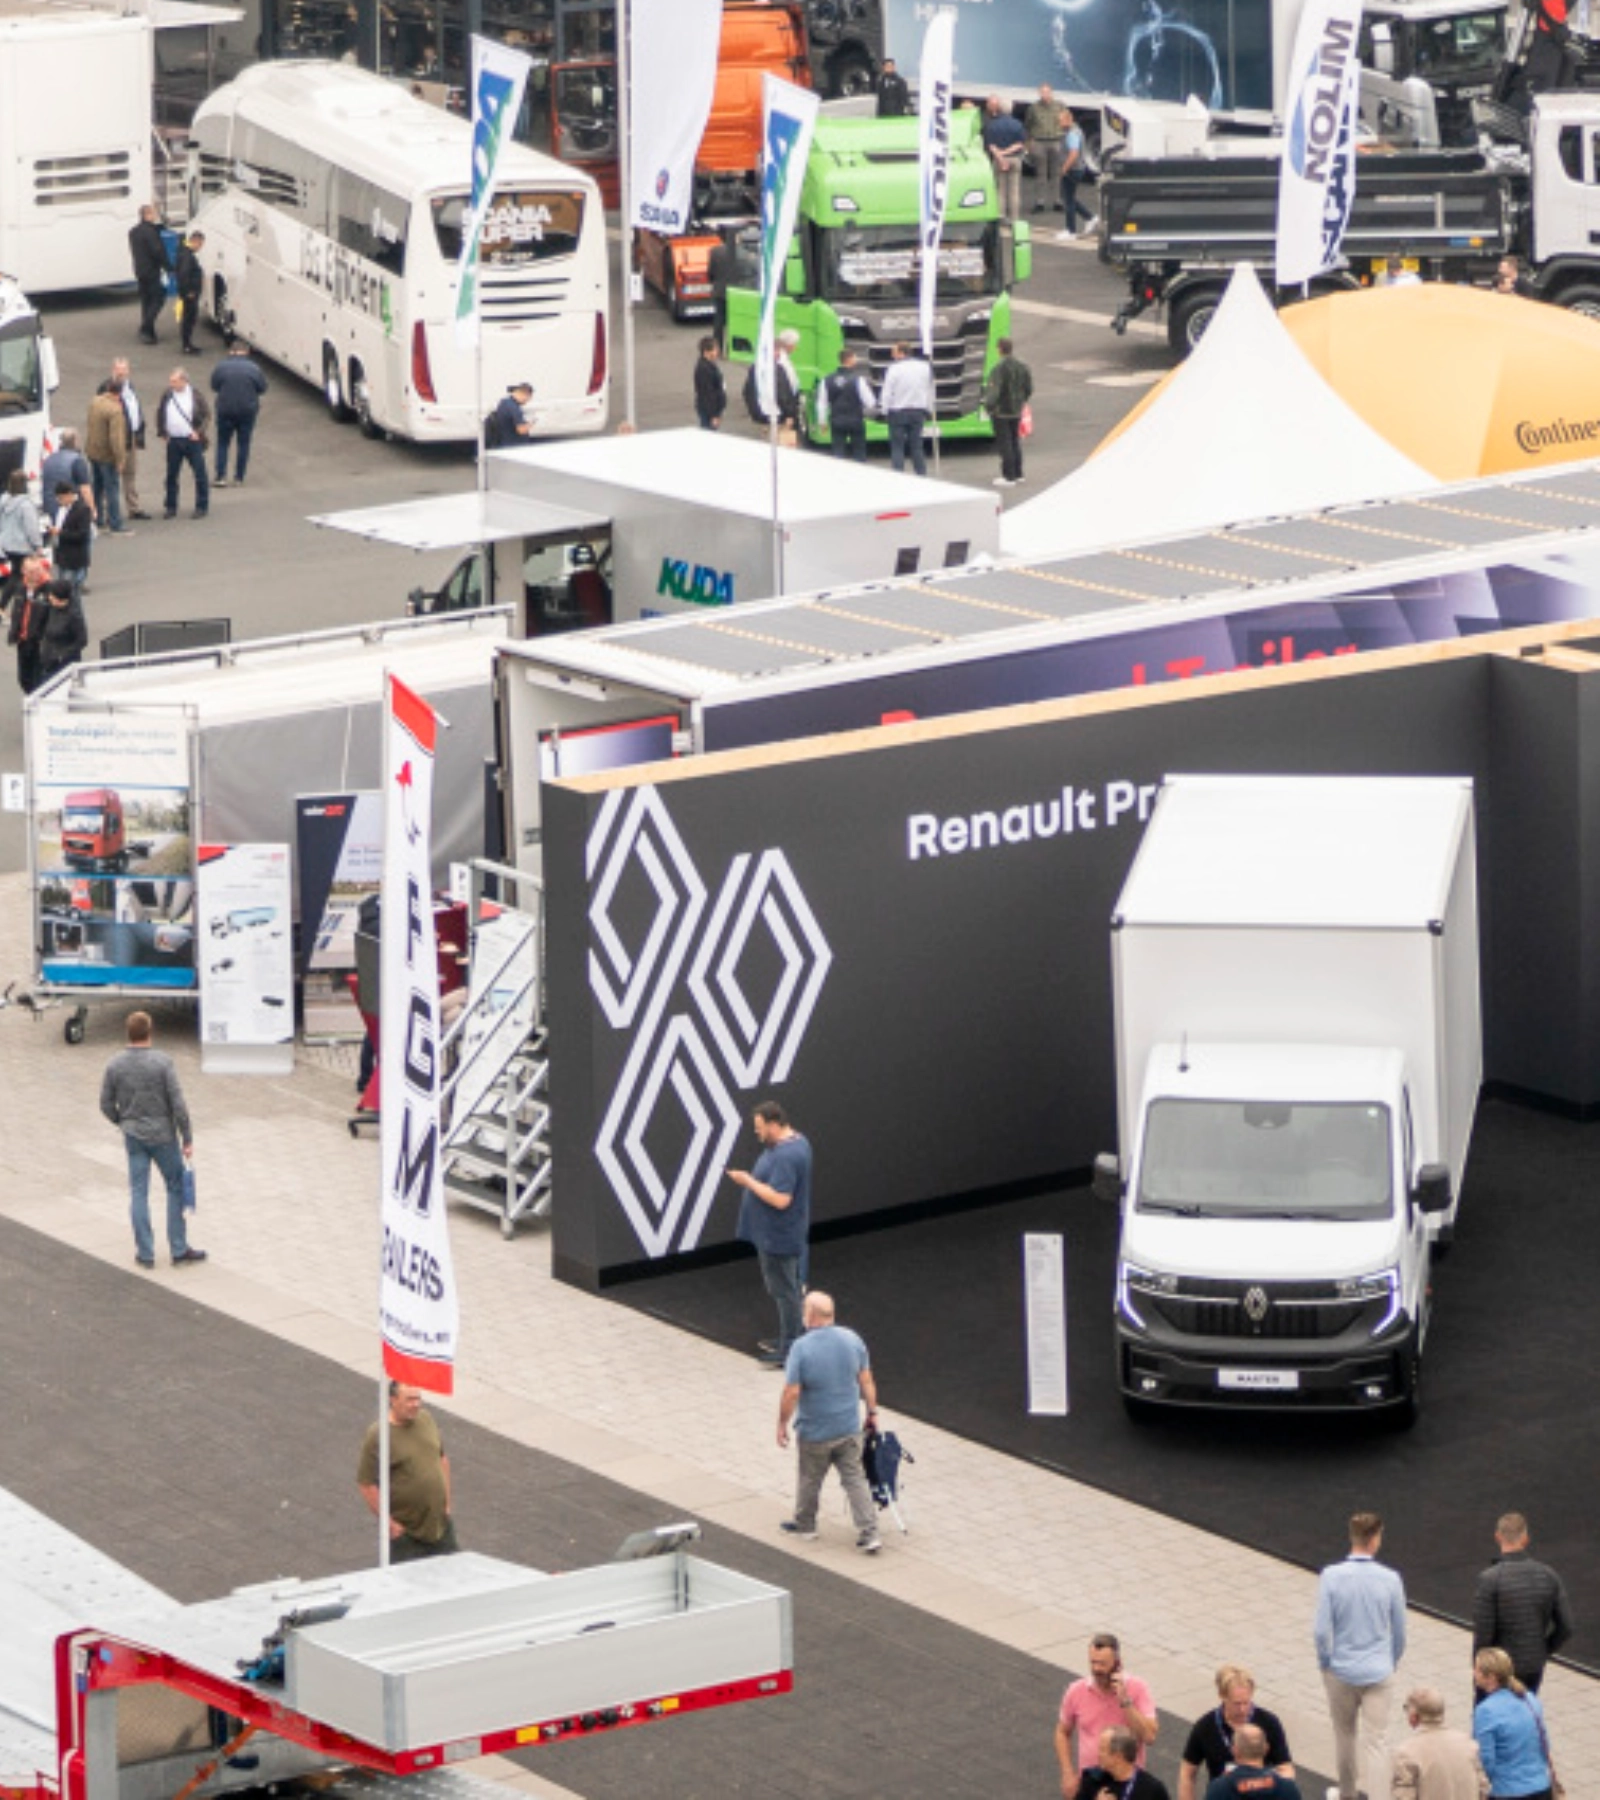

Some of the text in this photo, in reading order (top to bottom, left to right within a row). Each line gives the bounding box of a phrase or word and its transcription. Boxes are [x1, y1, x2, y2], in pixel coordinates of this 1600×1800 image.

[657, 556, 735, 606] KUDA
[907, 779, 1160, 860] Renault Pr
